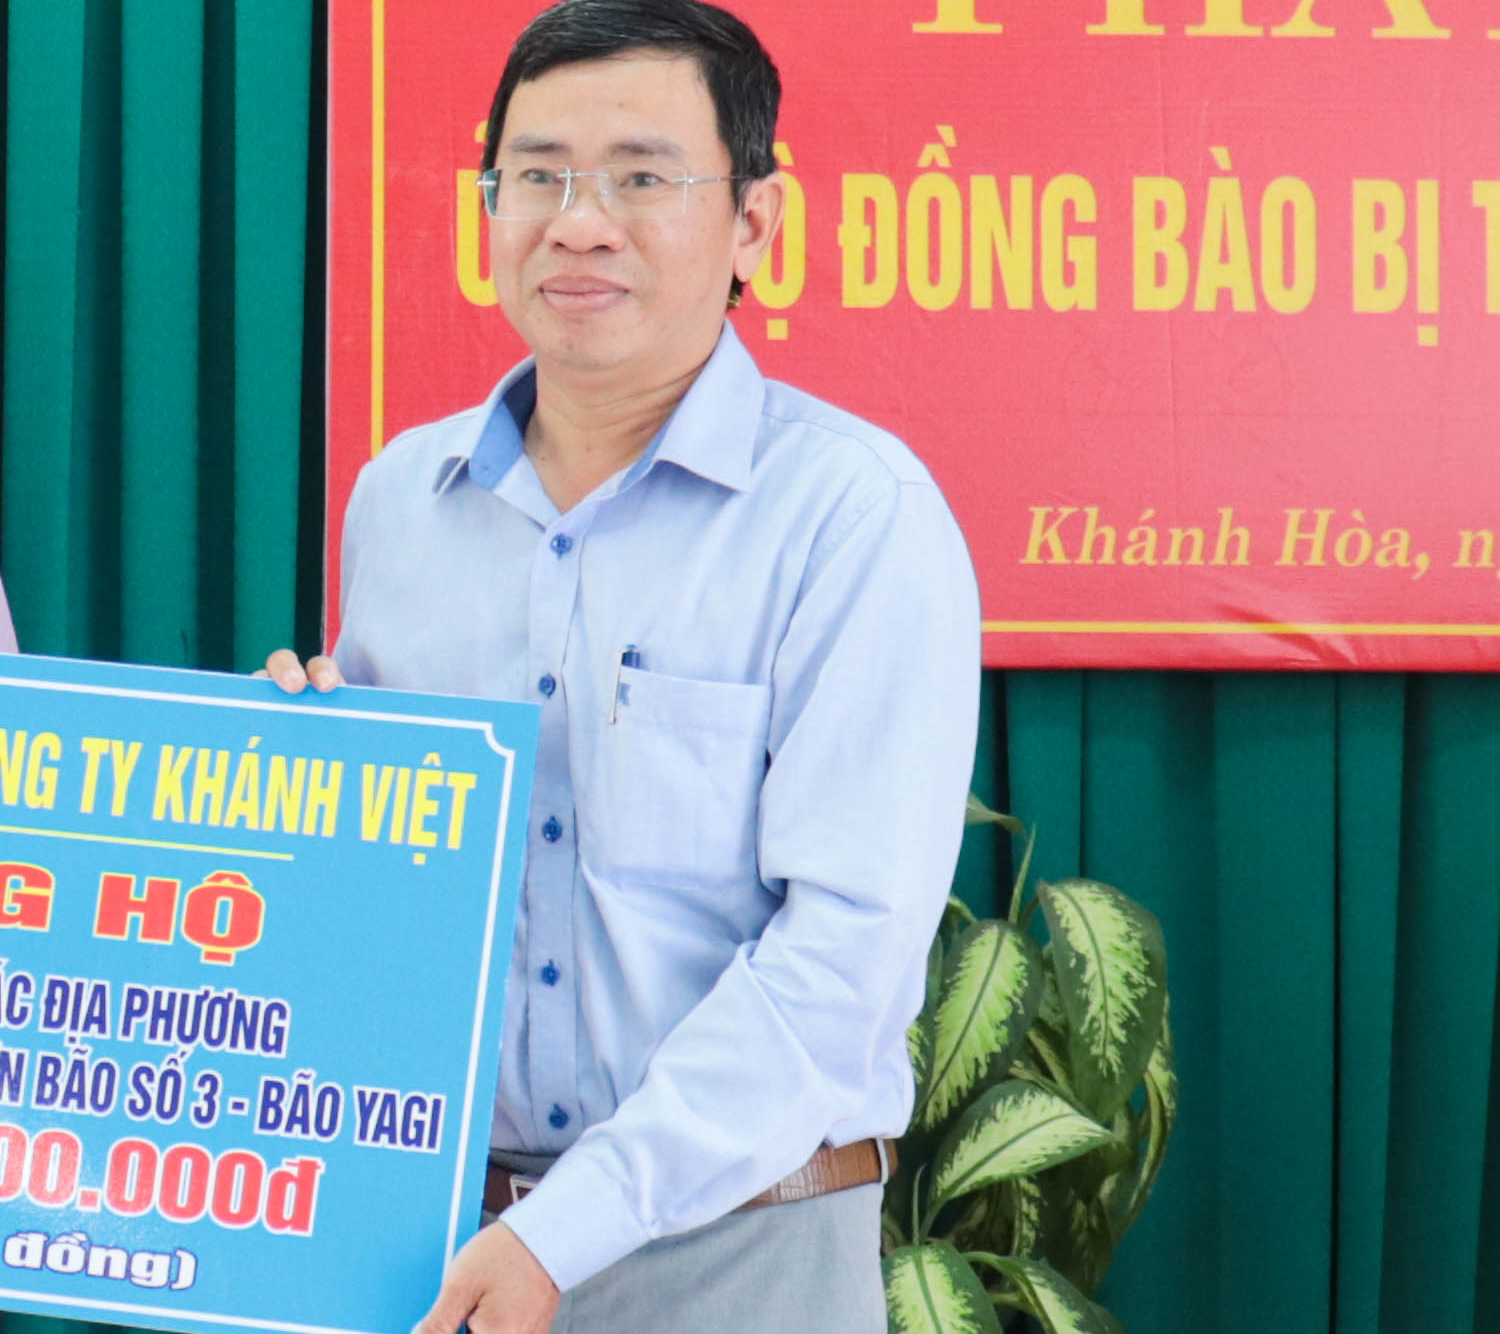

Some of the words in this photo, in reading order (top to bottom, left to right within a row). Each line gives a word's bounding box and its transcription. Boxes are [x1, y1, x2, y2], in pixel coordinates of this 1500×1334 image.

[838, 124, 1097, 312] ĐỒNG
[1130, 147, 1315, 312] BÀO
[1352, 177, 1440, 345] BỊ
[1019, 506, 1251, 567] Khánh
[1274, 506, 1432, 578] Hòa,
[79, 735, 143, 818] TY
[152, 736, 342, 836] KHÁNH
[359, 751, 477, 866] VIỆT
[92, 870, 266, 967] HỘ
[39, 973, 108, 1047] ĐỊA
[119, 984, 291, 1059] PHƯƠNG
[32, 1044, 118, 1117] BÃO
[124, 1046, 194, 1124] SỐ
[190, 1069, 222, 1128] 3
[255, 1068, 344, 1141] BÃO
[352, 1085, 446, 1153] YAGI
[3, 1221, 197, 1292] đồng)
